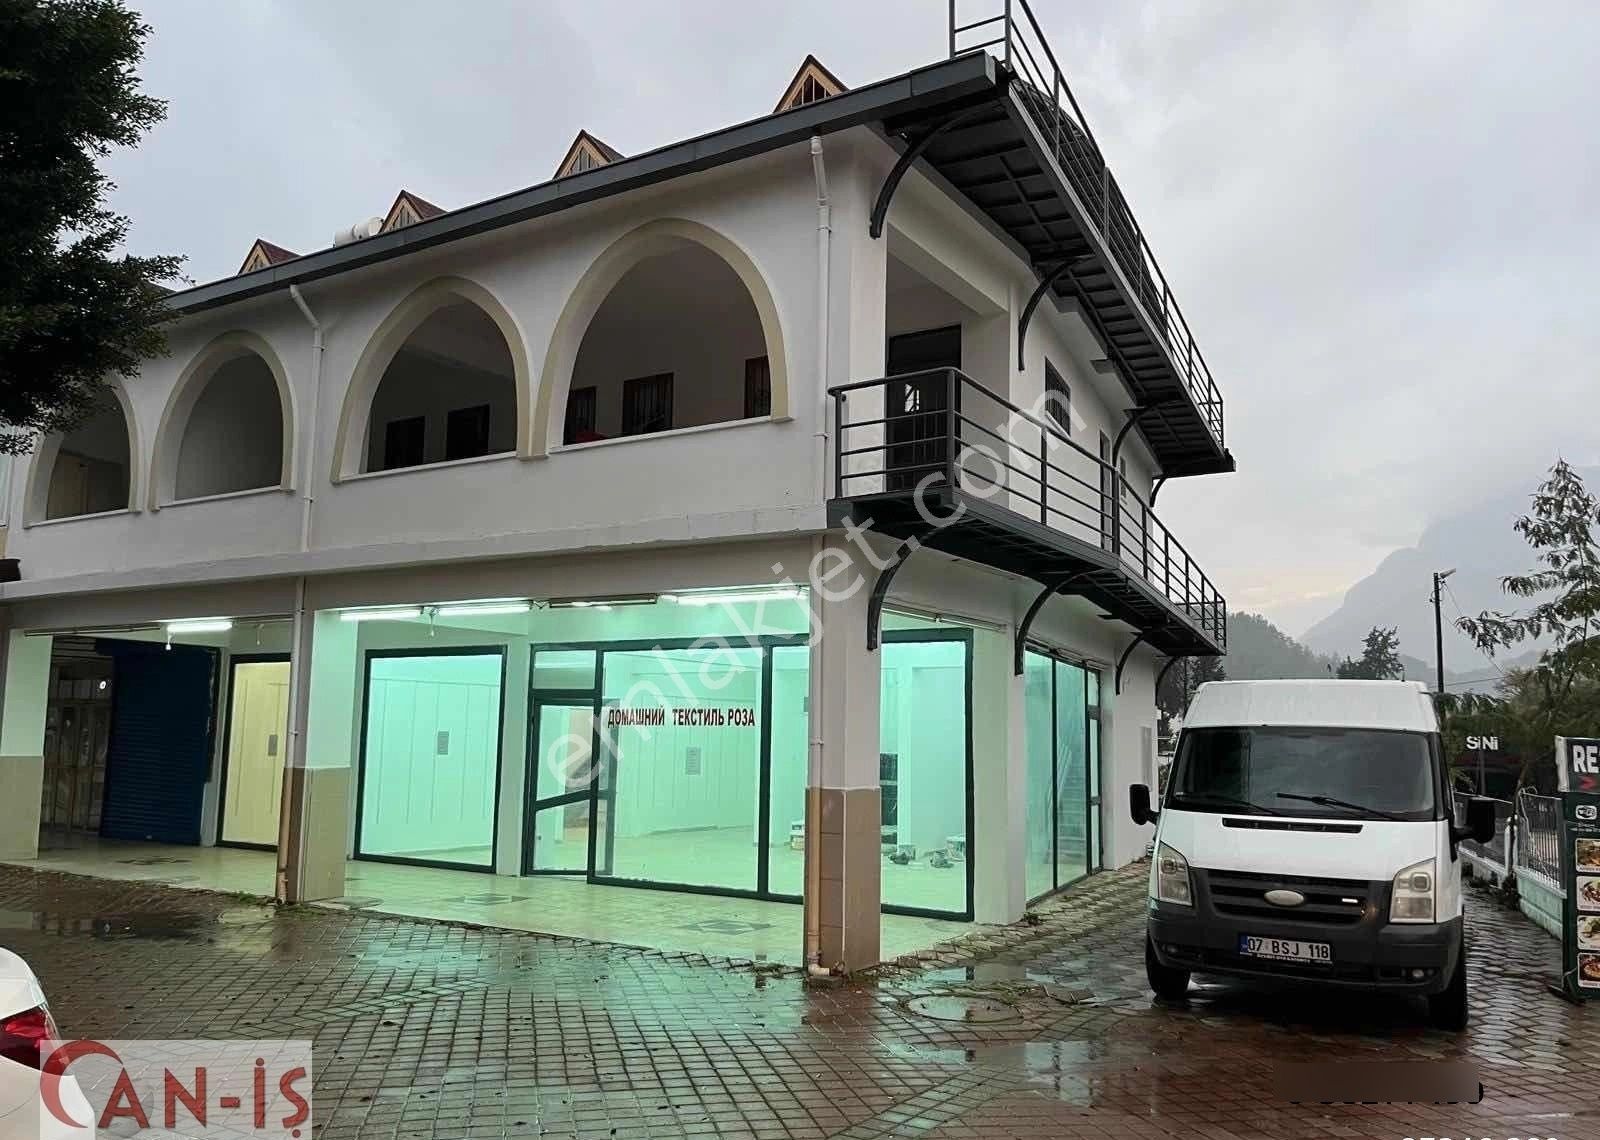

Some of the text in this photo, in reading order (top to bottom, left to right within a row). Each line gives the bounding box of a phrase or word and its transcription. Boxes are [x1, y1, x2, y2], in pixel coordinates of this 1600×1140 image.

[608, 705, 756, 728] ДОМАШНИЙ ТЕКСТИЛЬ РОЗА
[1248, 938, 1263, 951] 07
[1271, 940, 1299, 956] BSJ
[1309, 944, 1329, 958] 118
